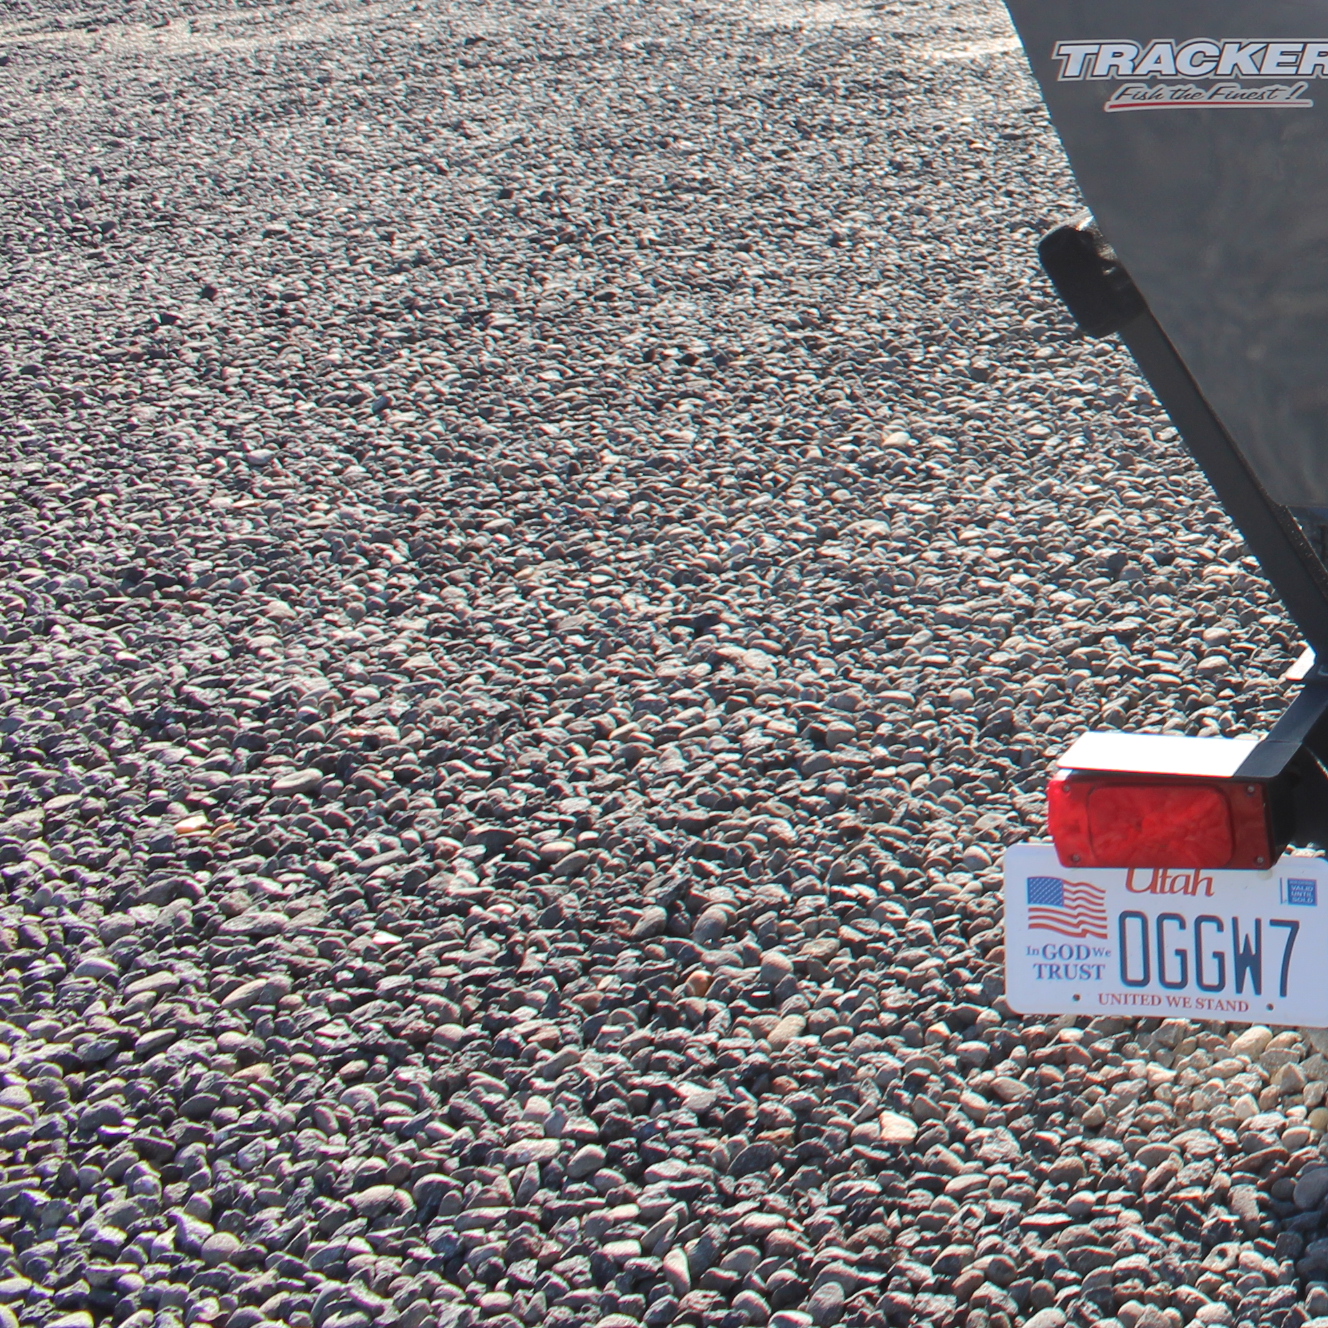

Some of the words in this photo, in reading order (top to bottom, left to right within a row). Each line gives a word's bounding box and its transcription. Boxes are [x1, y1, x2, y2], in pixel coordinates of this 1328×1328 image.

[1114, 85, 1163, 102] Fish
[1169, 83, 1203, 101] the
[1124, 868, 1215, 898] Utah
[1026, 945, 1040, 957] In
[1042, 944, 1092, 961] GOD
[1092, 946, 1112, 958] We
[1033, 963, 1106, 980] TRUST
[1098, 992, 1162, 1008] UNITED
[1166, 996, 1192, 1010] WE
[1195, 998, 1250, 1012] STAND
